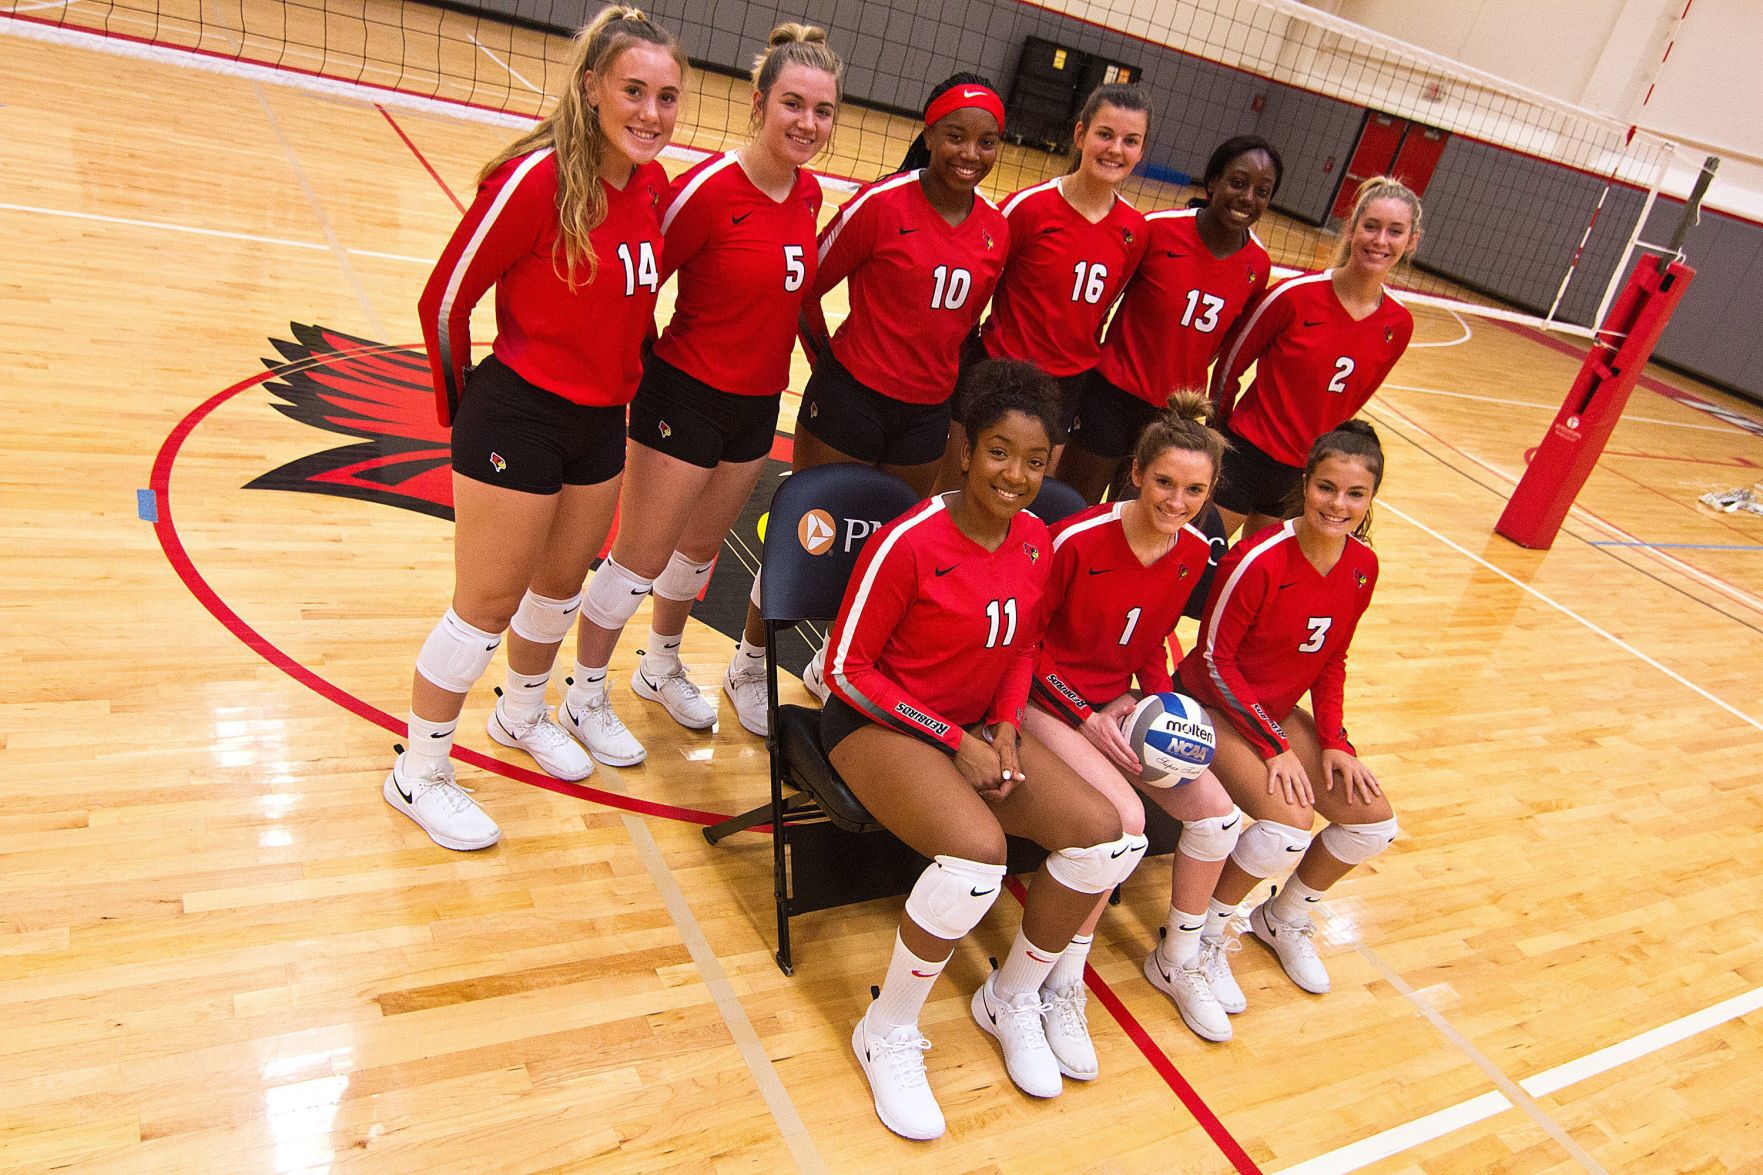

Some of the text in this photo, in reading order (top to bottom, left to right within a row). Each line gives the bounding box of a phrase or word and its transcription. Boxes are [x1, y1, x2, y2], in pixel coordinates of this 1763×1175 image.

[616, 241, 660, 297] 14
[782, 244, 806, 293] 5
[930, 264, 972, 311] 10
[1070, 260, 1109, 305] 16
[1179, 288, 1226, 334] 13
[1326, 355, 1356, 394] 2
[984, 597, 1018, 649] 11
[1118, 606, 1142, 646] 1
[1297, 616, 1333, 654] 3
[895, 702, 951, 737] REDBIRDS
[1166, 720, 1213, 743] molten
[1251, 703, 1287, 740] REDRDS
[1166, 737, 1209, 761] NCAA
